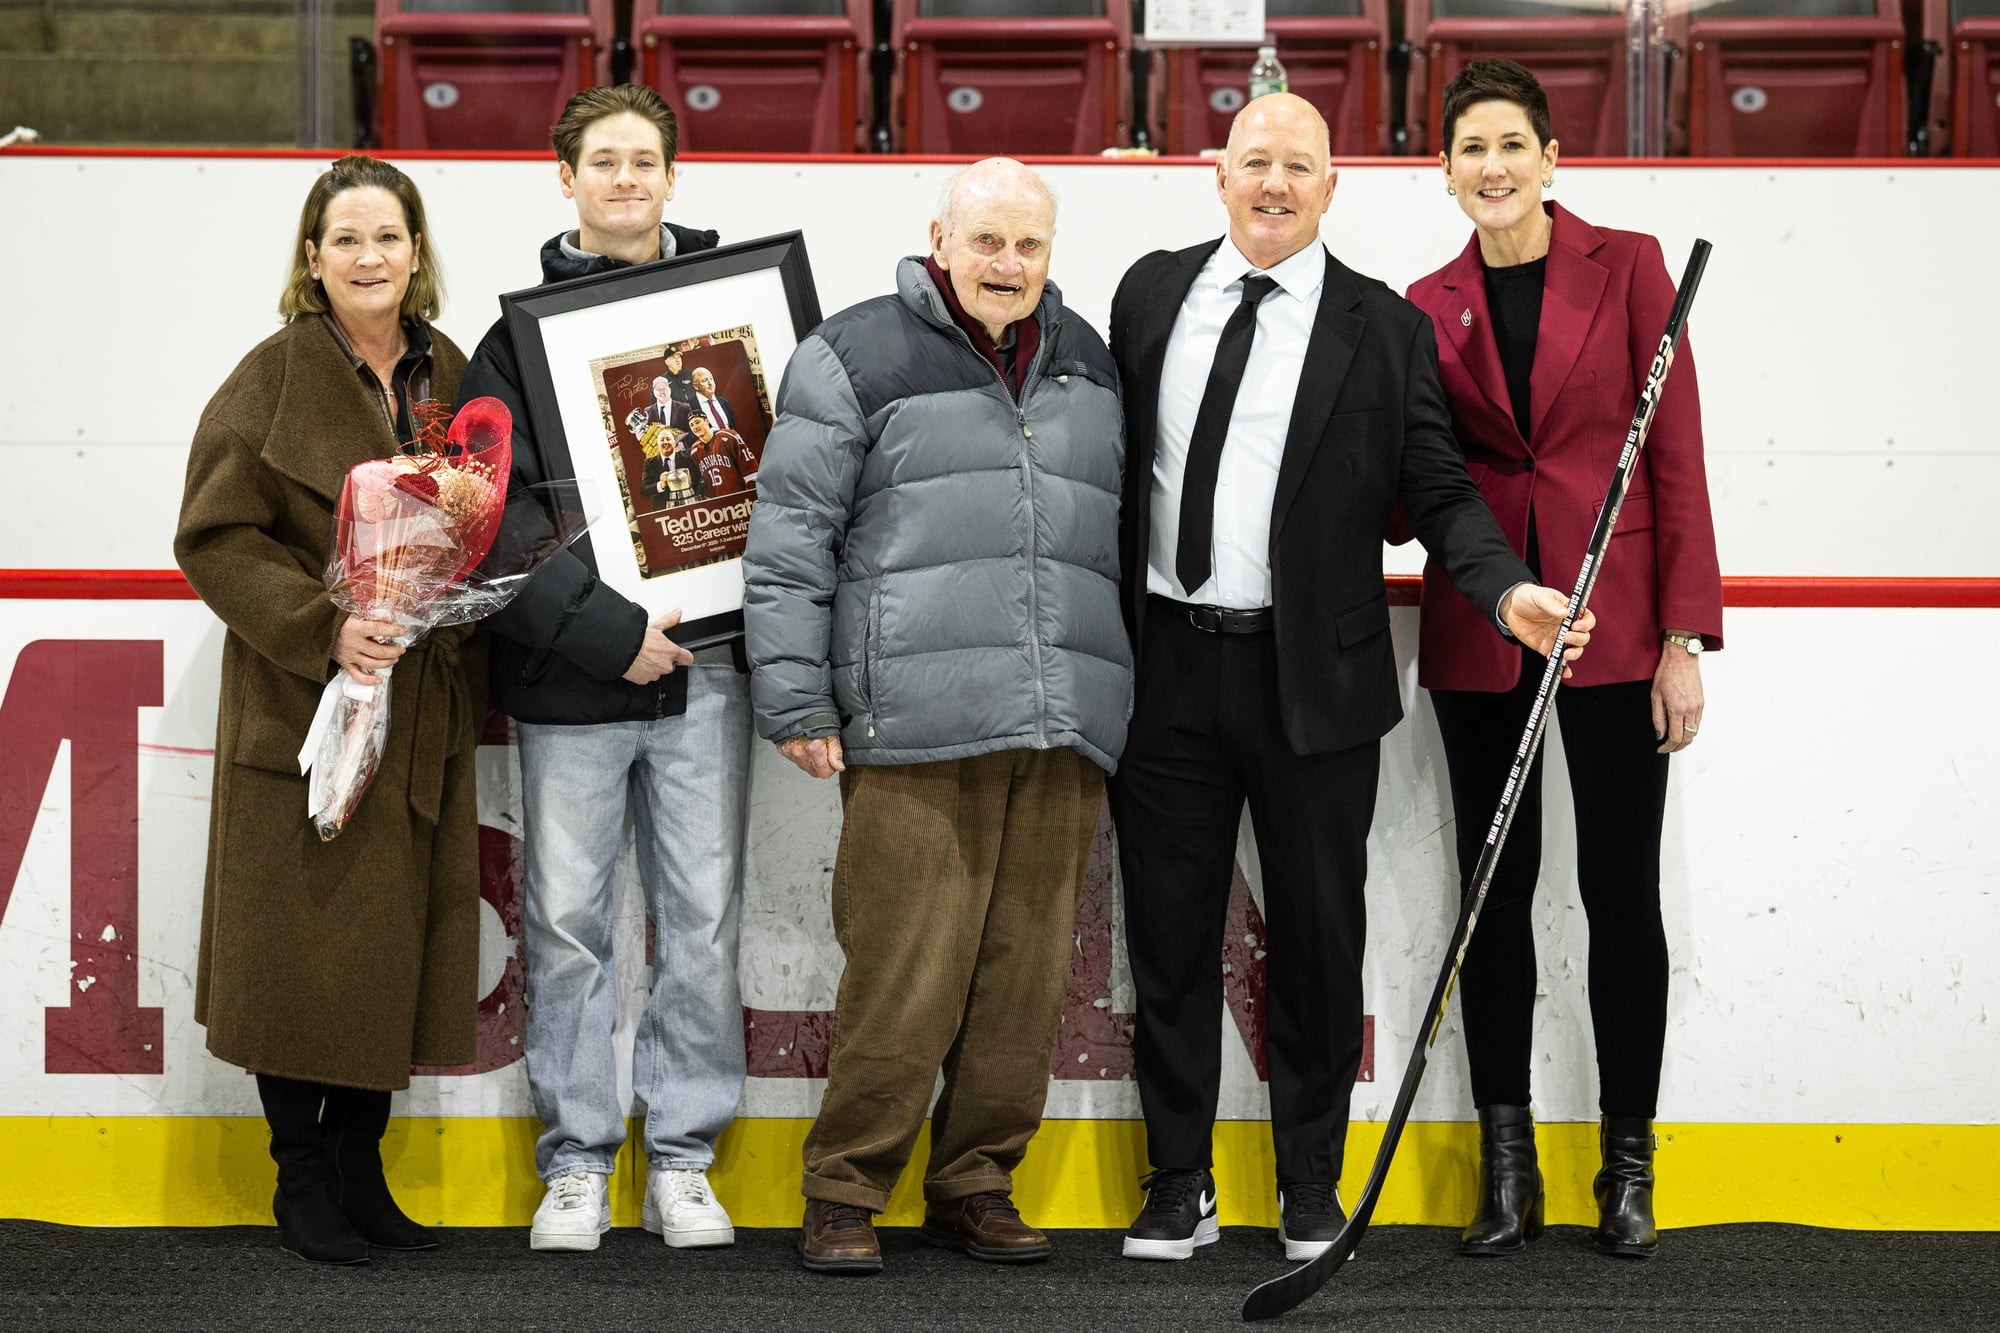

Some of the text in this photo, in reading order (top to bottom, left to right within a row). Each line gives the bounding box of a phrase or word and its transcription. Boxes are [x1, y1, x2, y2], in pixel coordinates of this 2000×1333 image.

[1641, 334, 1672, 402] CCM
[1618, 430, 1638, 469] TED DONATO
[654, 510, 694, 536] Ted
[672, 519, 752, 547] 325 Career win
[1573, 553, 1594, 595] WINNINGEST
[1552, 626, 1568, 657] HARVARD
[1538, 657, 1558, 696] UNIVERSITY
[1526, 695, 1544, 730] PROGRAM
[1517, 728, 1533, 758] HISTORY
[1510, 764, 1521, 778] TED
[1500, 777, 1516, 805] DONATO
[1486, 825, 1499, 845] WINS
